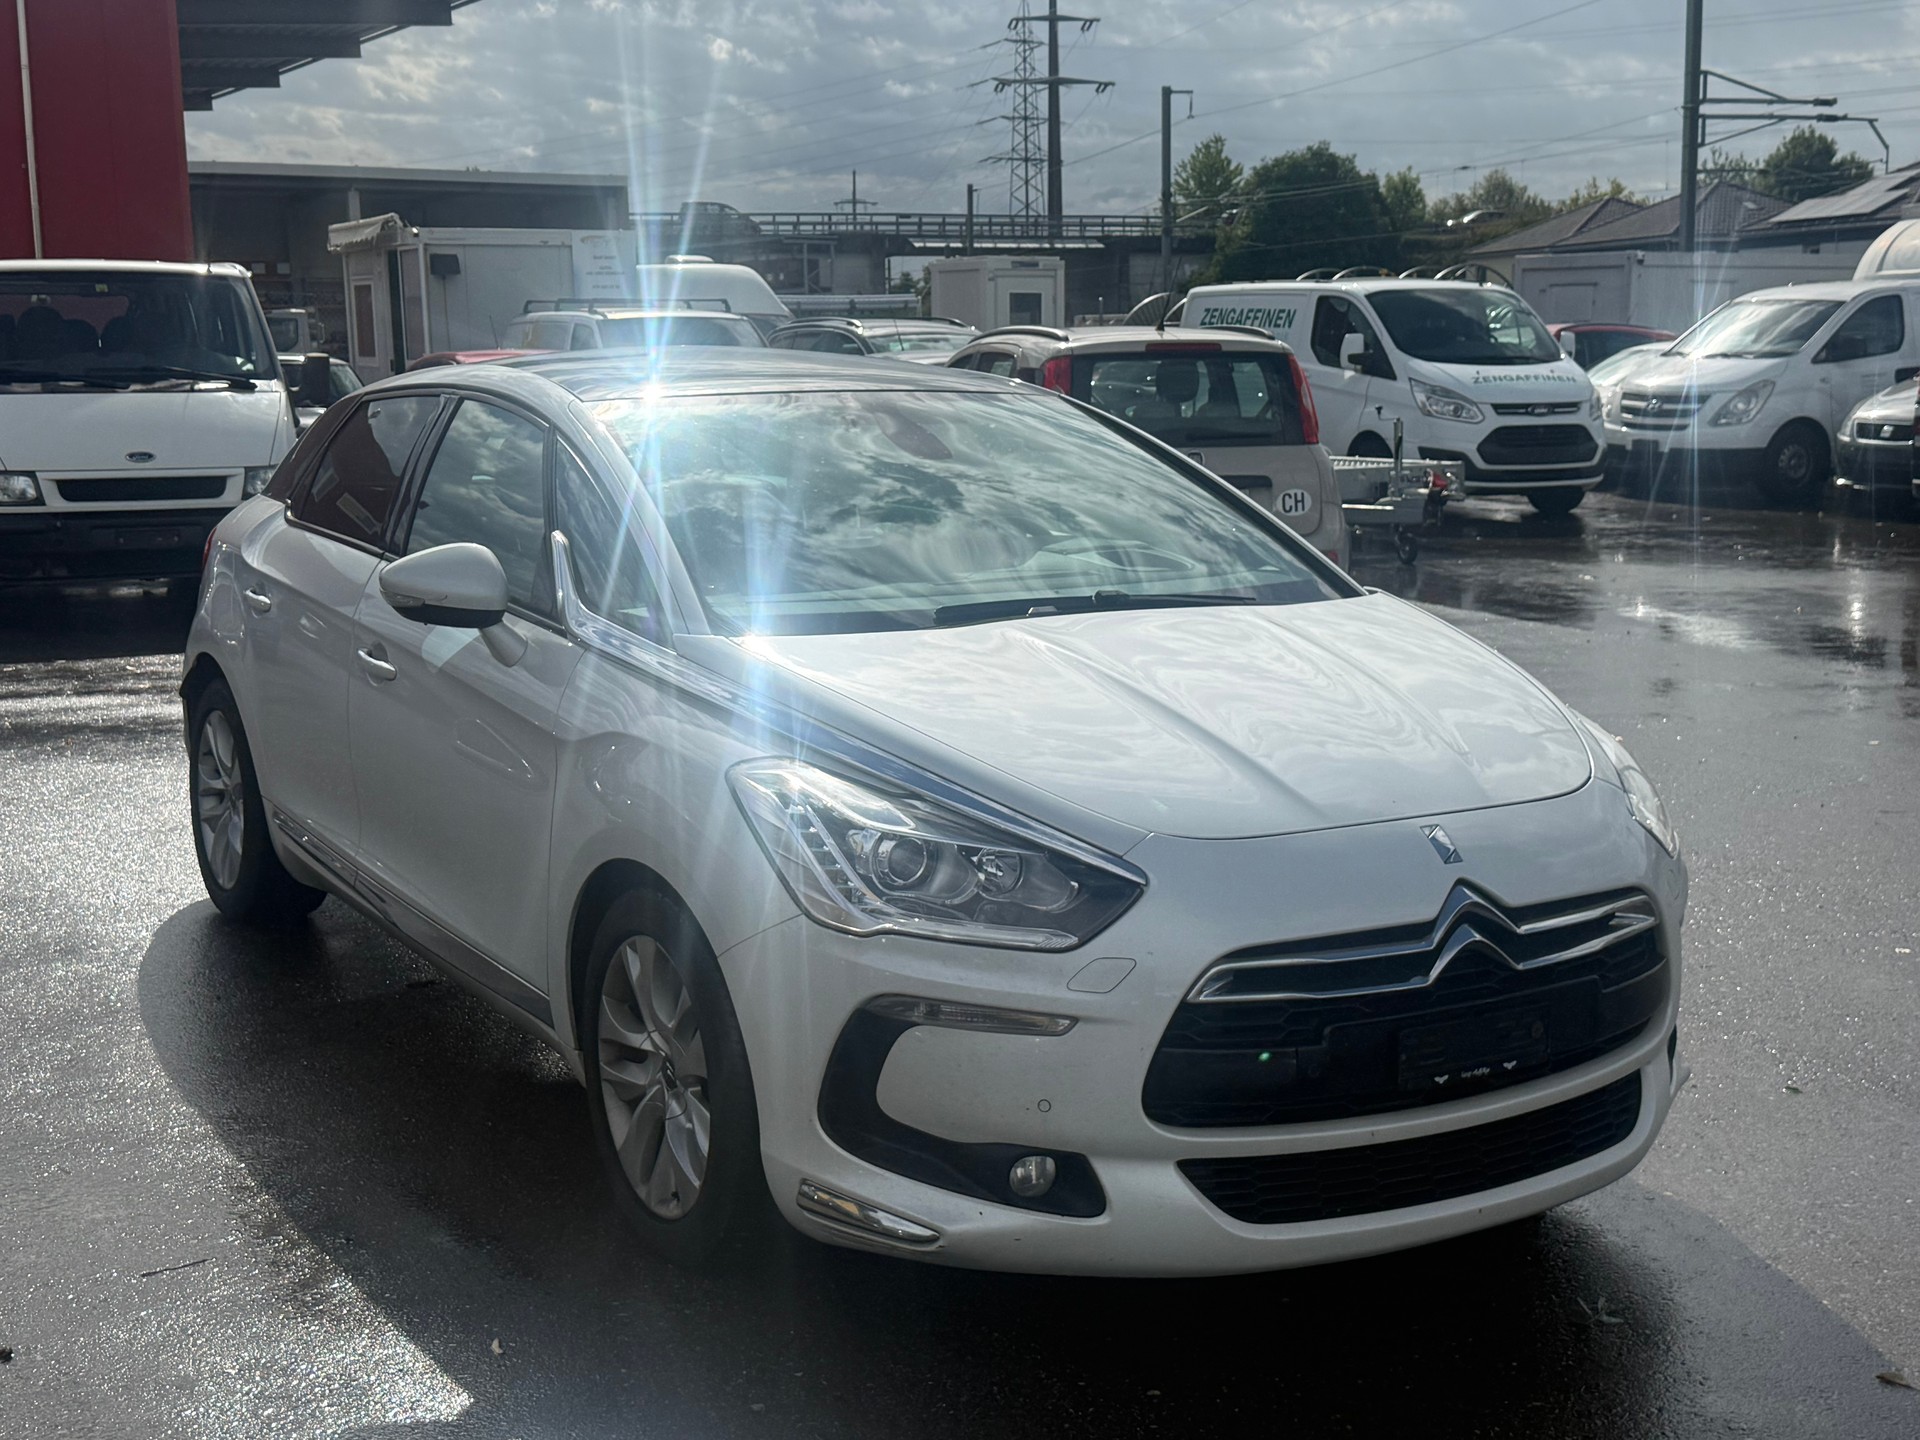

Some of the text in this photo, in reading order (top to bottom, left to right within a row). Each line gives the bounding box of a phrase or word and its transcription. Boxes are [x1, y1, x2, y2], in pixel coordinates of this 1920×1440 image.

[1200, 307, 1297, 329] ZENGAFFINEN
[1472, 374, 1577, 384] ZENGAFFINEN
[1282, 491, 1306, 513] CH
